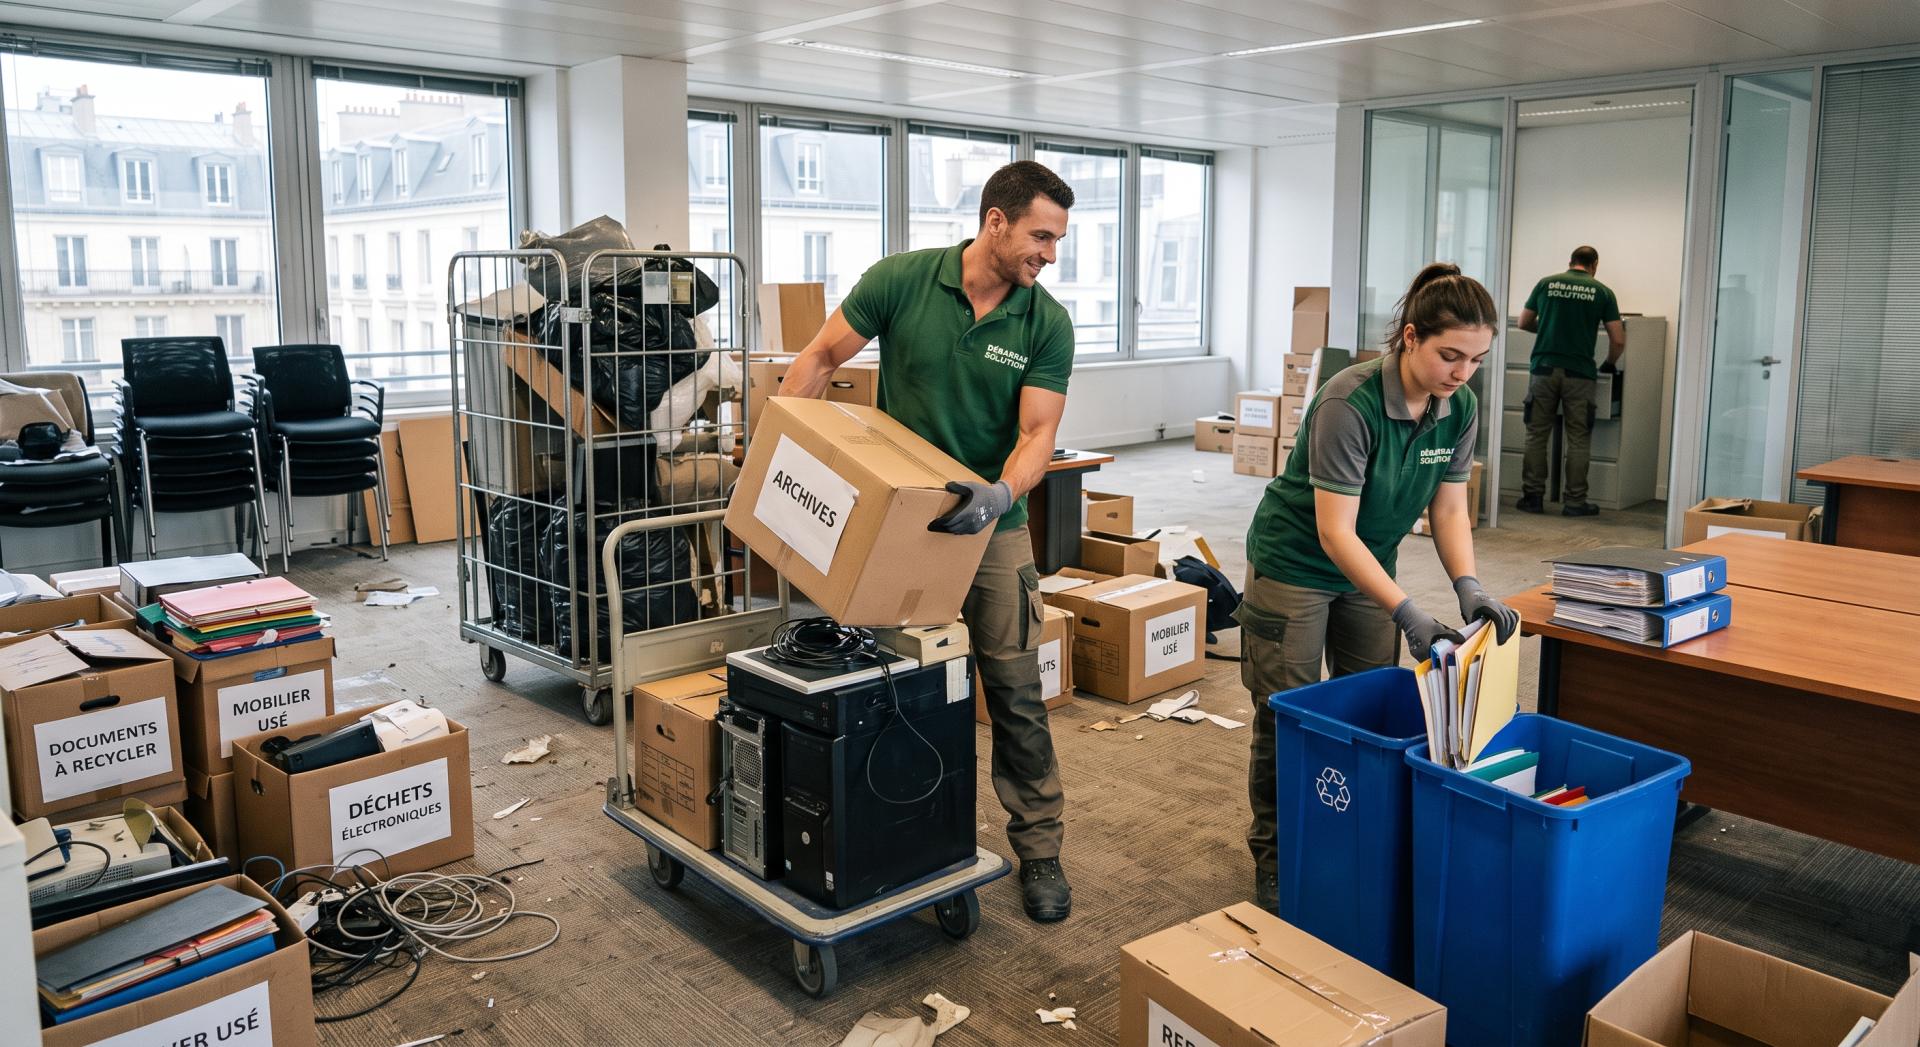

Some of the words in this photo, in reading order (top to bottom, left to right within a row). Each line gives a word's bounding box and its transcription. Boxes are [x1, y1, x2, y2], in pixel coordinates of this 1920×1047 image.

[1547, 290, 1595, 301] SOLUTION
[1548, 281, 1596, 294] DÉBARRAS
[984, 352, 1025, 370] SOLUTION
[772, 470, 837, 528] ARCHIVES
[1151, 621, 1190, 643] MOBILIER
[1162, 640, 1178, 656] USÉ
[1039, 659, 1056, 674] UTS
[233, 688, 310, 716] MOBILIER
[258, 711, 288, 732] USÉ
[49, 721, 157, 757] DOCUMENTS
[54, 761, 68, 777] À
[72, 743, 157, 773] RECYCLER
[349, 782, 433, 820] DÉCHETS
[341, 802, 442, 841] ÉLECTRONIQUES
[216, 1007, 259, 1042] USÉ
